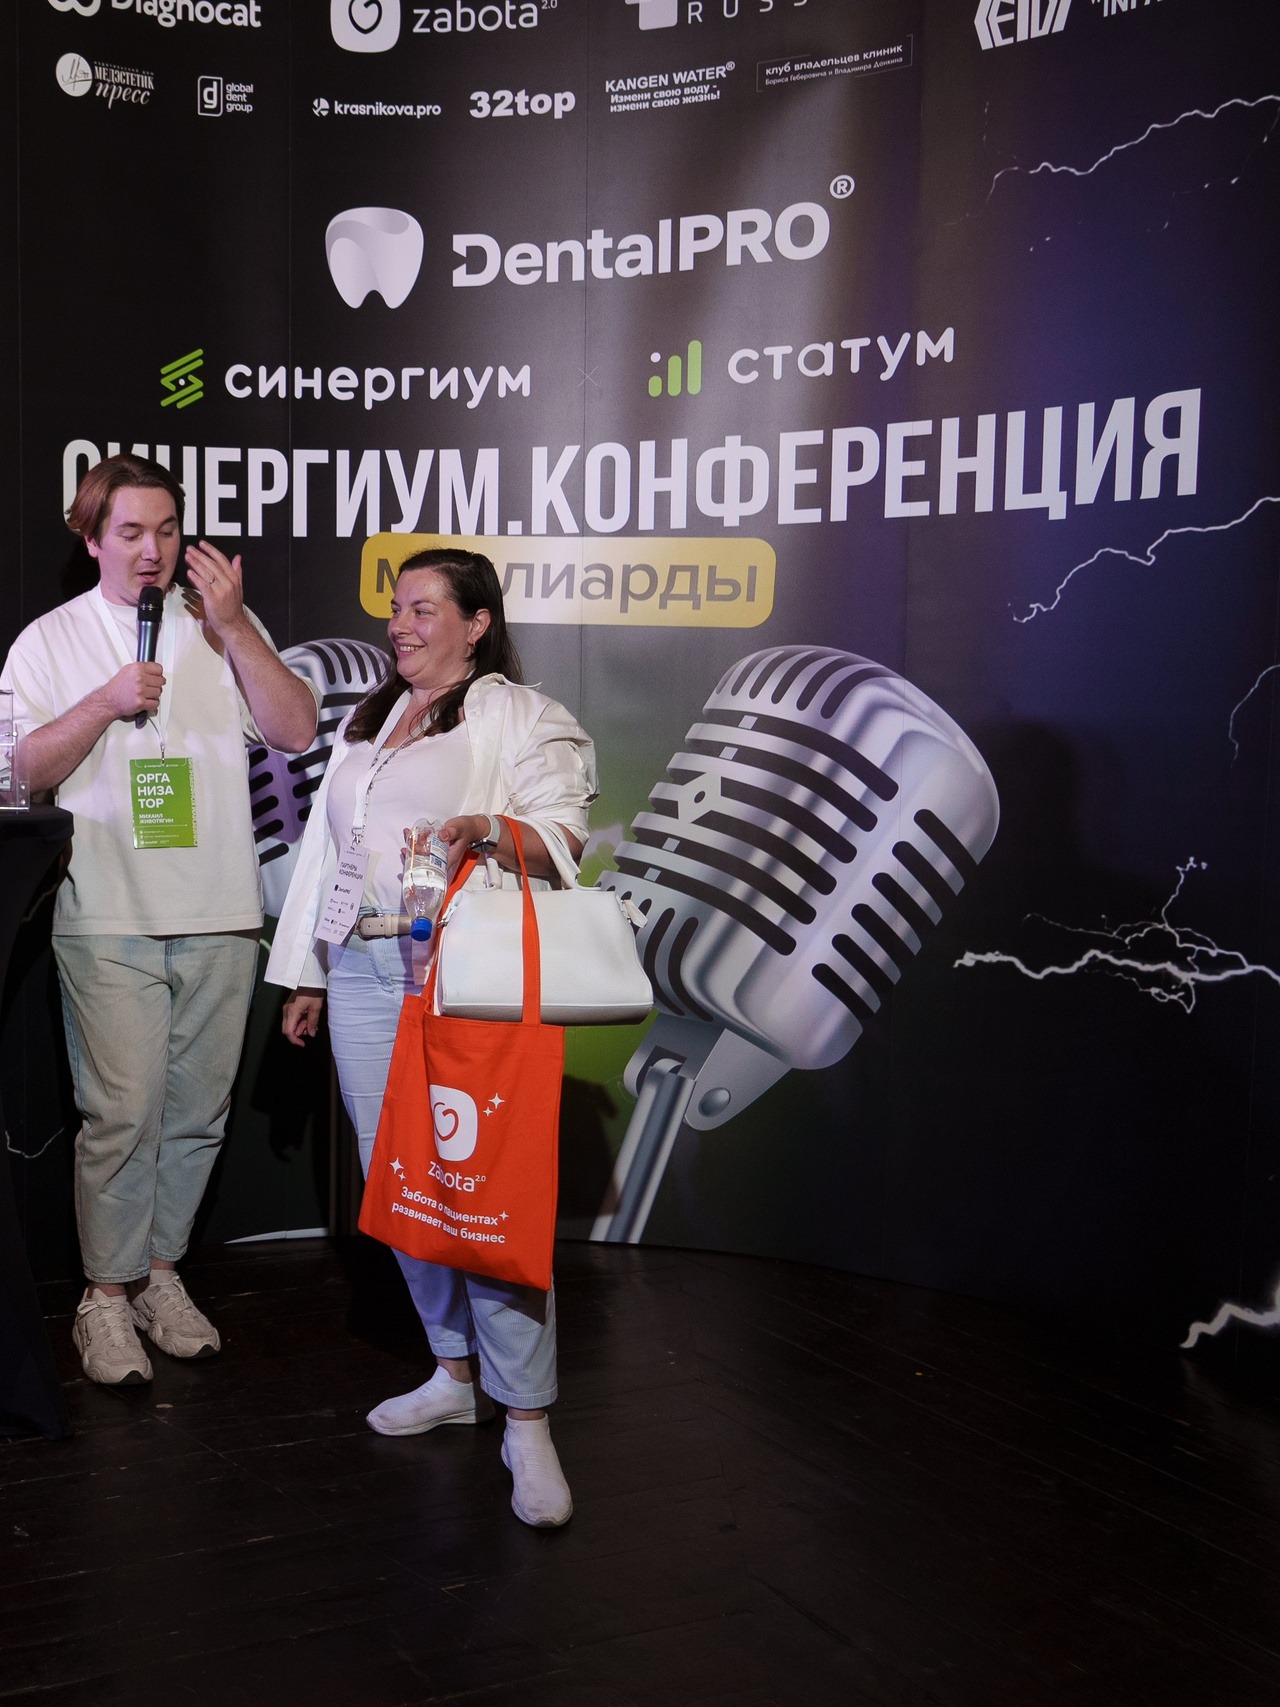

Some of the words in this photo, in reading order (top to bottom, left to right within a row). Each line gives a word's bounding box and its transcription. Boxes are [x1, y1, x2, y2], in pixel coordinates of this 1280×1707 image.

[111, 0, 262, 28] agnocat
[412, 0, 539, 33] zabota
[687, 0, 808, 24] RUS
[765, 62, 791, 76] клуб
[794, 53, 860, 71] владельцев
[863, 44, 903, 60] клиник
[834, 64, 872, 76] Владимира
[225, 82, 254, 94] global
[605, 74, 668, 93] KANGEN
[610, 92, 651, 104] Измени
[653, 89, 682, 99] свою
[684, 84, 710, 95] воду
[226, 92, 247, 103] dent
[226, 102, 253, 114] group
[469, 88, 576, 120] 32top
[610, 102, 649, 113] измени
[652, 99, 680, 109] свою
[682, 90, 721, 105] жизнь!
[334, 100, 442, 119] krasnikova.pro
[727, 327, 955, 384] статум
[225, 362, 531, 409] синергиум
[62, 388, 1202, 538] СНЕРГИУМ.КОНФЕРЕНЦИЯ
[376, 558, 758, 614] млиарды
[136, 773, 170, 784] ОРГА
[137, 785, 174, 796] НИЗА
[138, 798, 164, 809] ТОР
[401, 1186, 437, 1209] Забота
[444, 1205, 499, 1226] пациентах
[391, 1202, 442, 1229] развивает
[443, 1222, 458, 1237] ваш
[460, 1228, 506, 1243] бизнес
